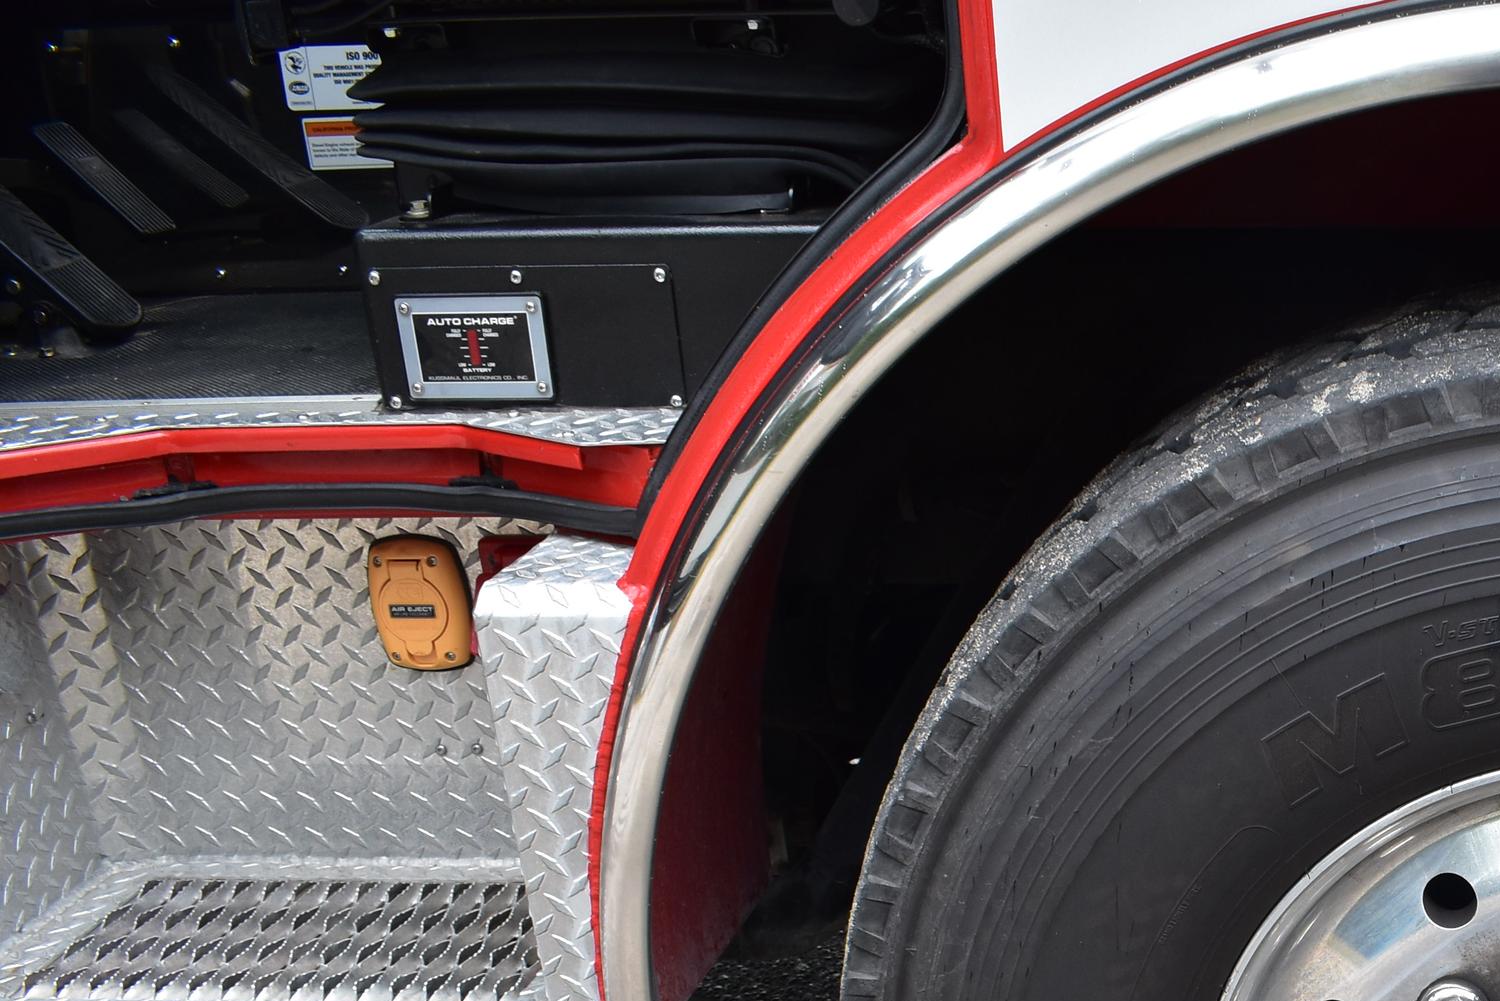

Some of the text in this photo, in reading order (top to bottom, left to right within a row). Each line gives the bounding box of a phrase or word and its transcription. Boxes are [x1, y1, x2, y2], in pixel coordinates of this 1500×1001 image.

[346, 52, 360, 60] ISO
[427, 316, 515, 326] AUTO CHARGE
